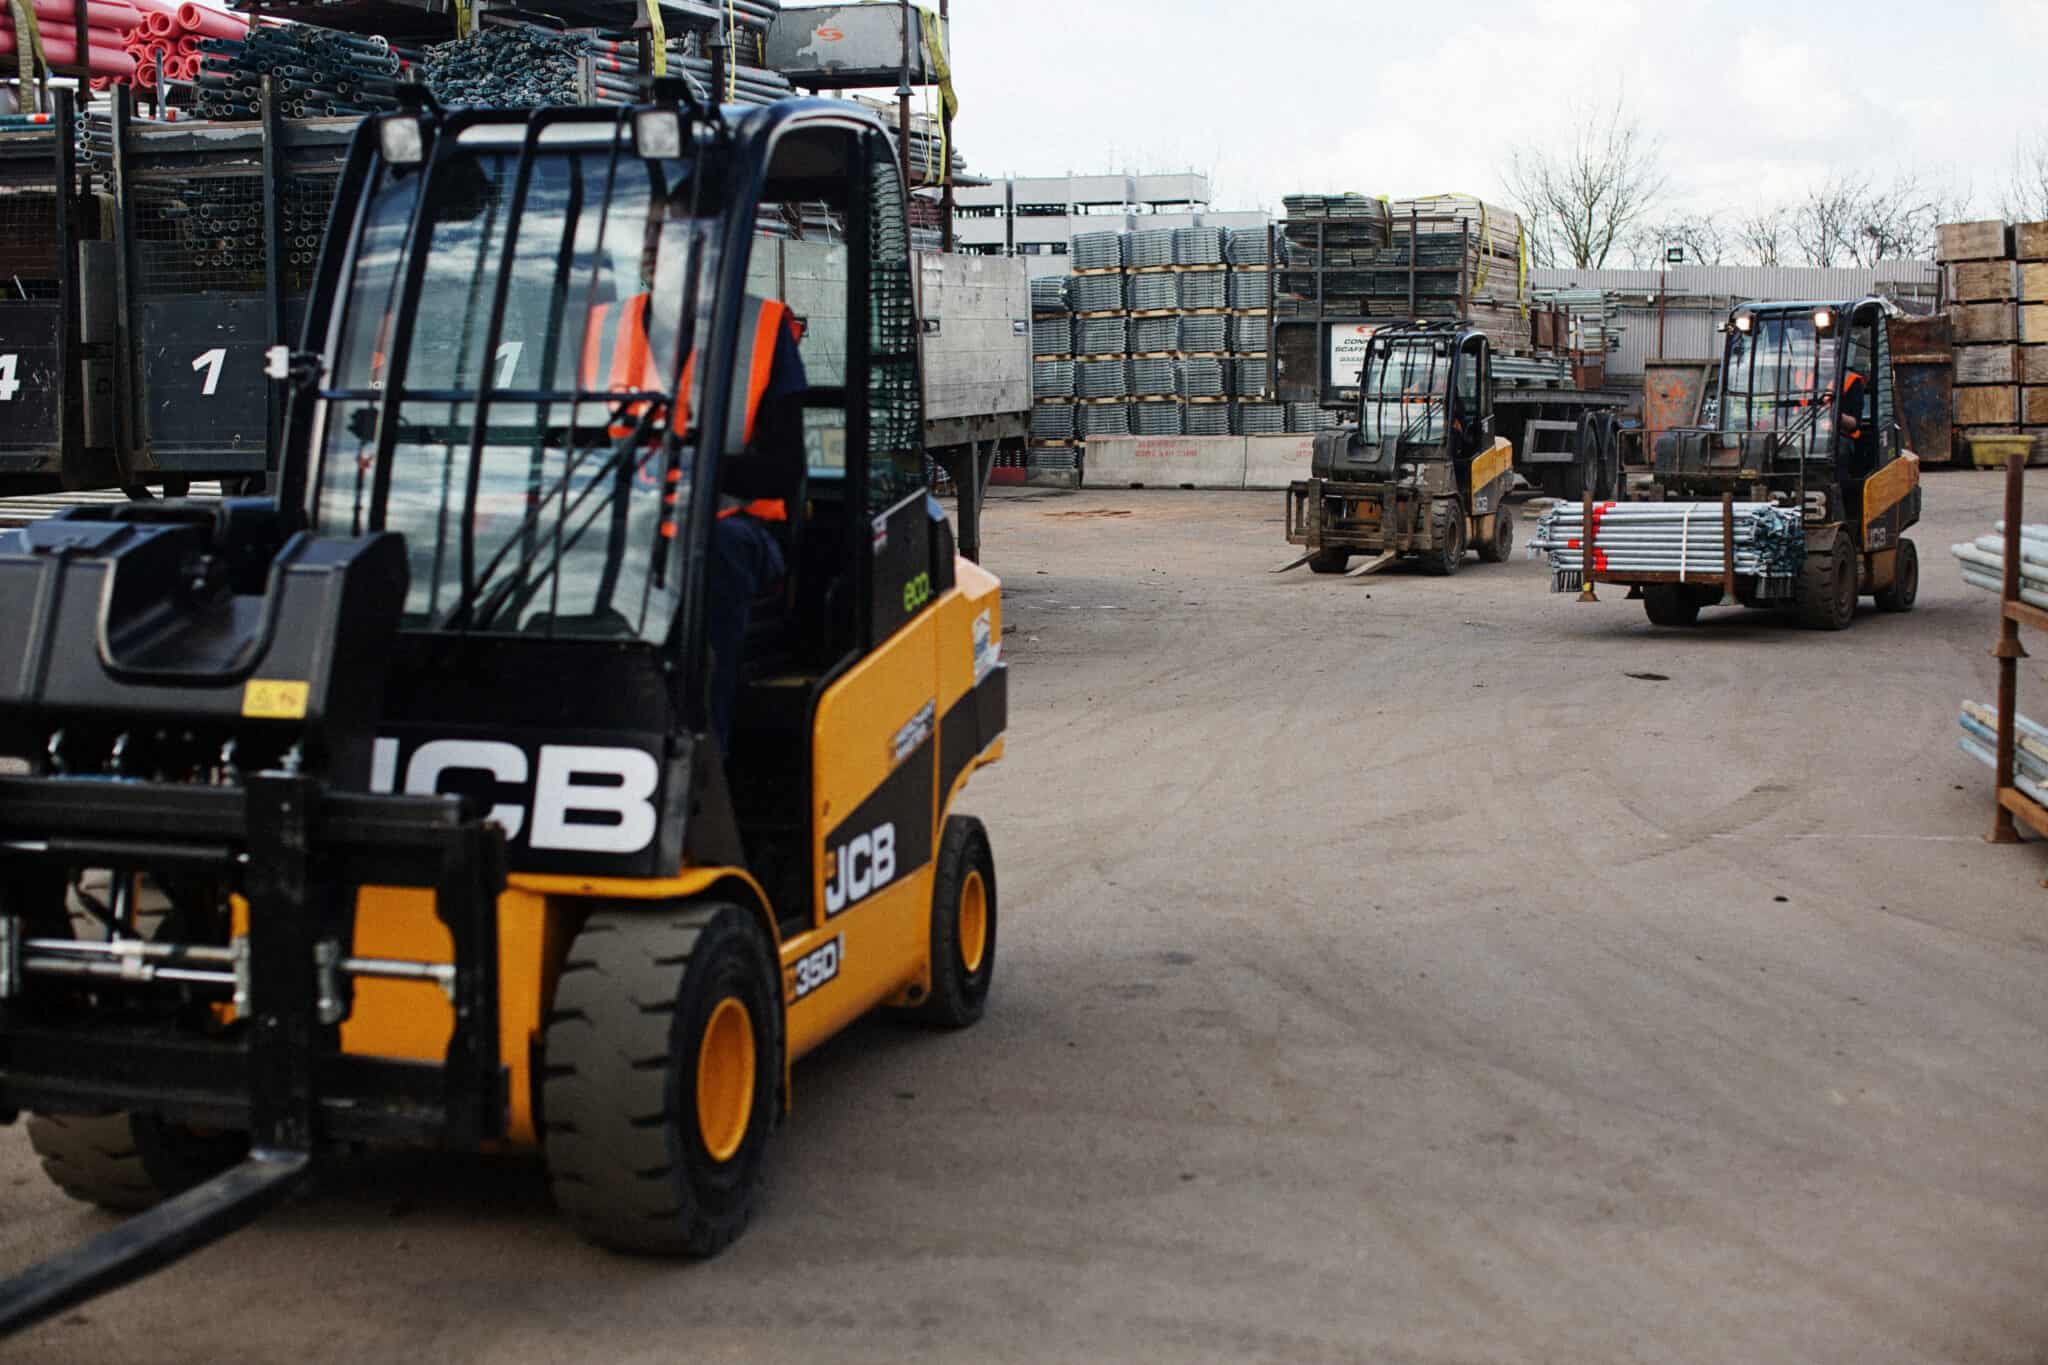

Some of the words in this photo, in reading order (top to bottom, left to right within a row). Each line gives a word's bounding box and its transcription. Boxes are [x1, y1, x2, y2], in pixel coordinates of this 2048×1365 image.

[192, 348, 227, 394] 1
[495, 341, 524, 389] 1
[903, 572, 930, 613] eco
[825, 821, 896, 915] JCB
